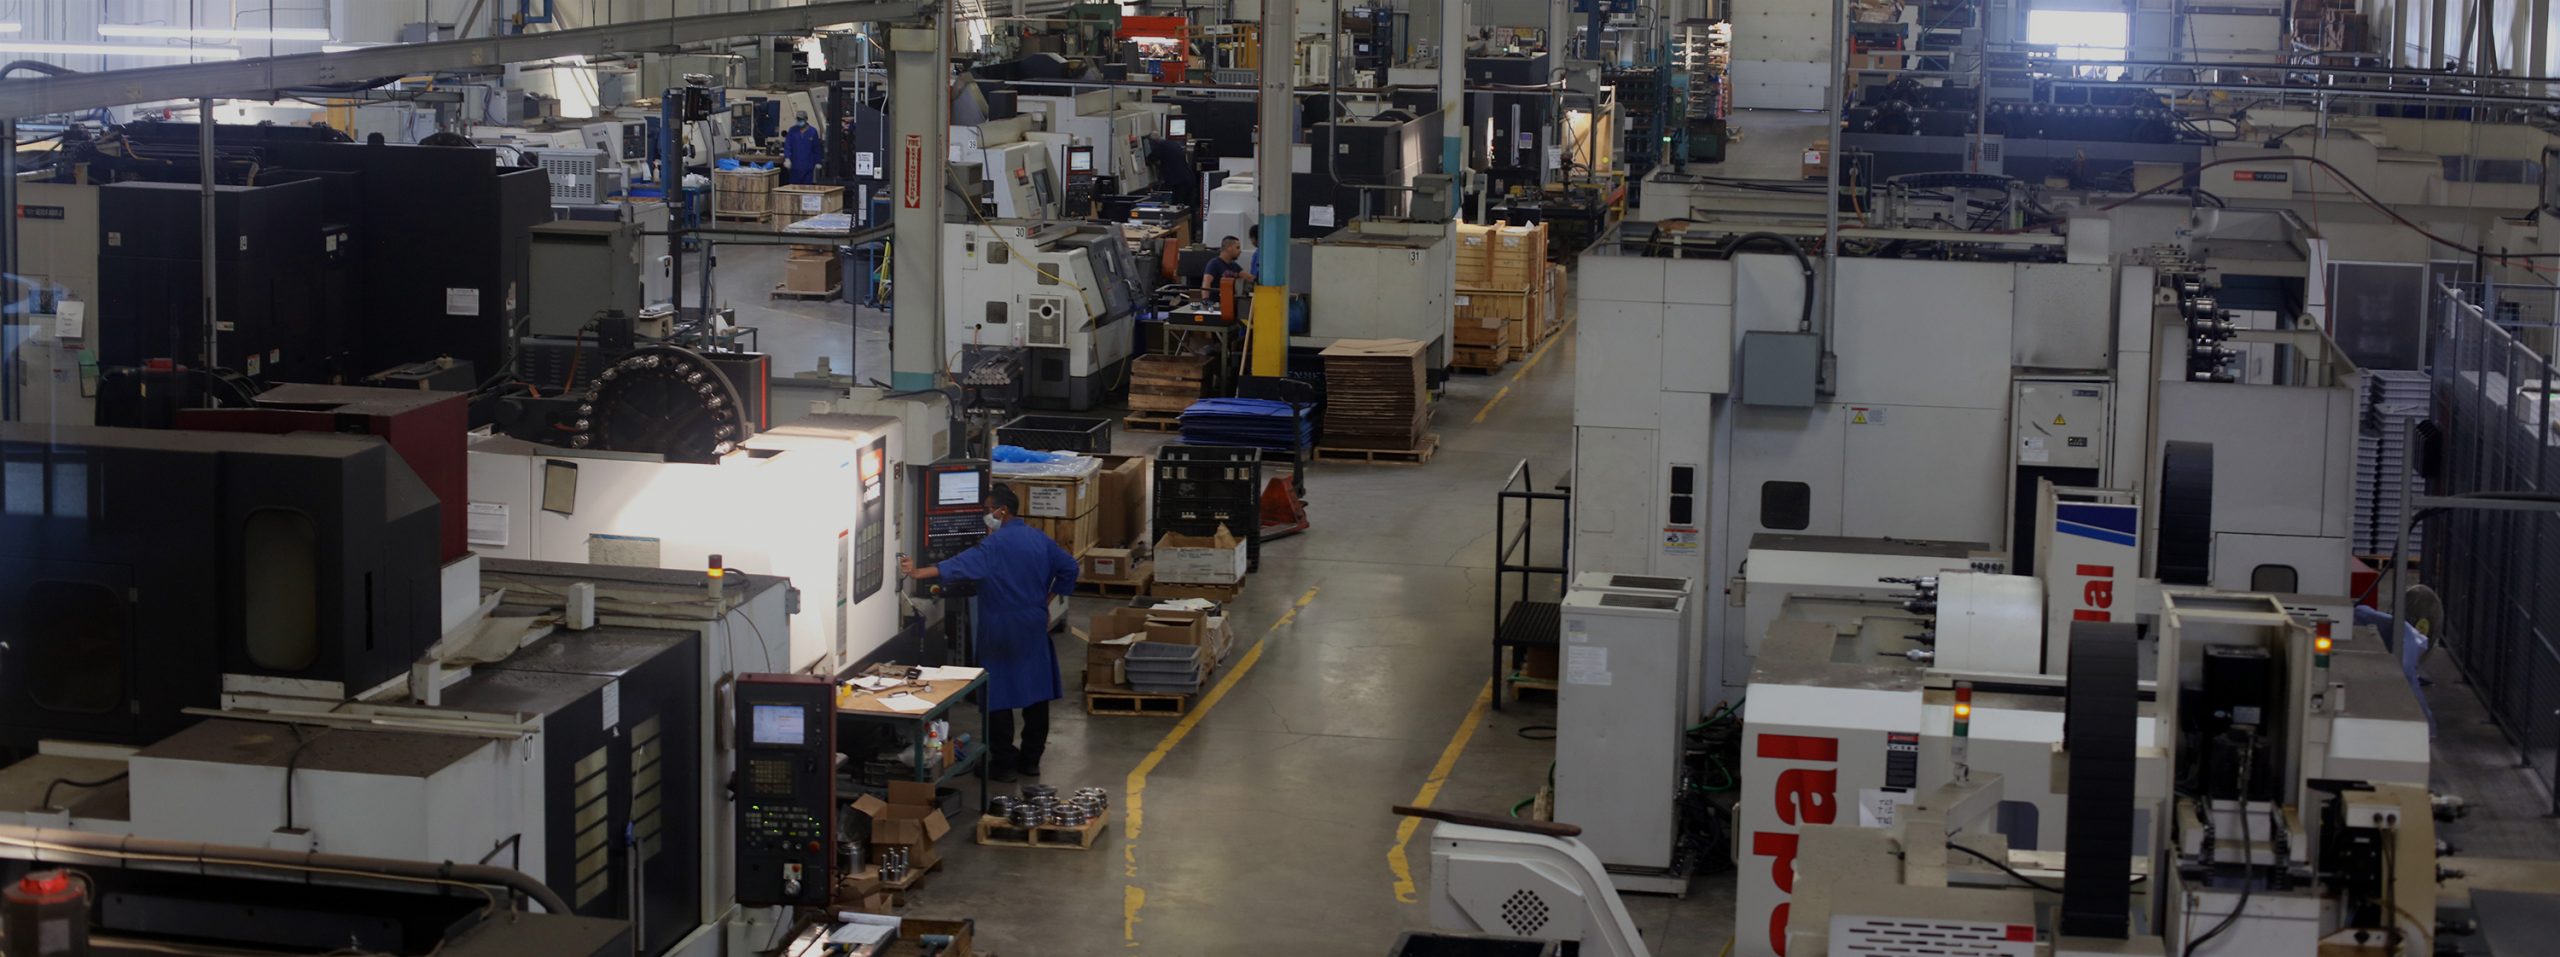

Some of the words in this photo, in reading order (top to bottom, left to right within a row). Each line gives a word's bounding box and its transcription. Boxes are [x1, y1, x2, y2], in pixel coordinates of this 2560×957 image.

[908, 139, 919, 147] FIRE
[909, 147, 917, 200] EXTINGUISHER
[1016, 227, 1025, 238] 30
[1410, 250, 1420, 262] 31
